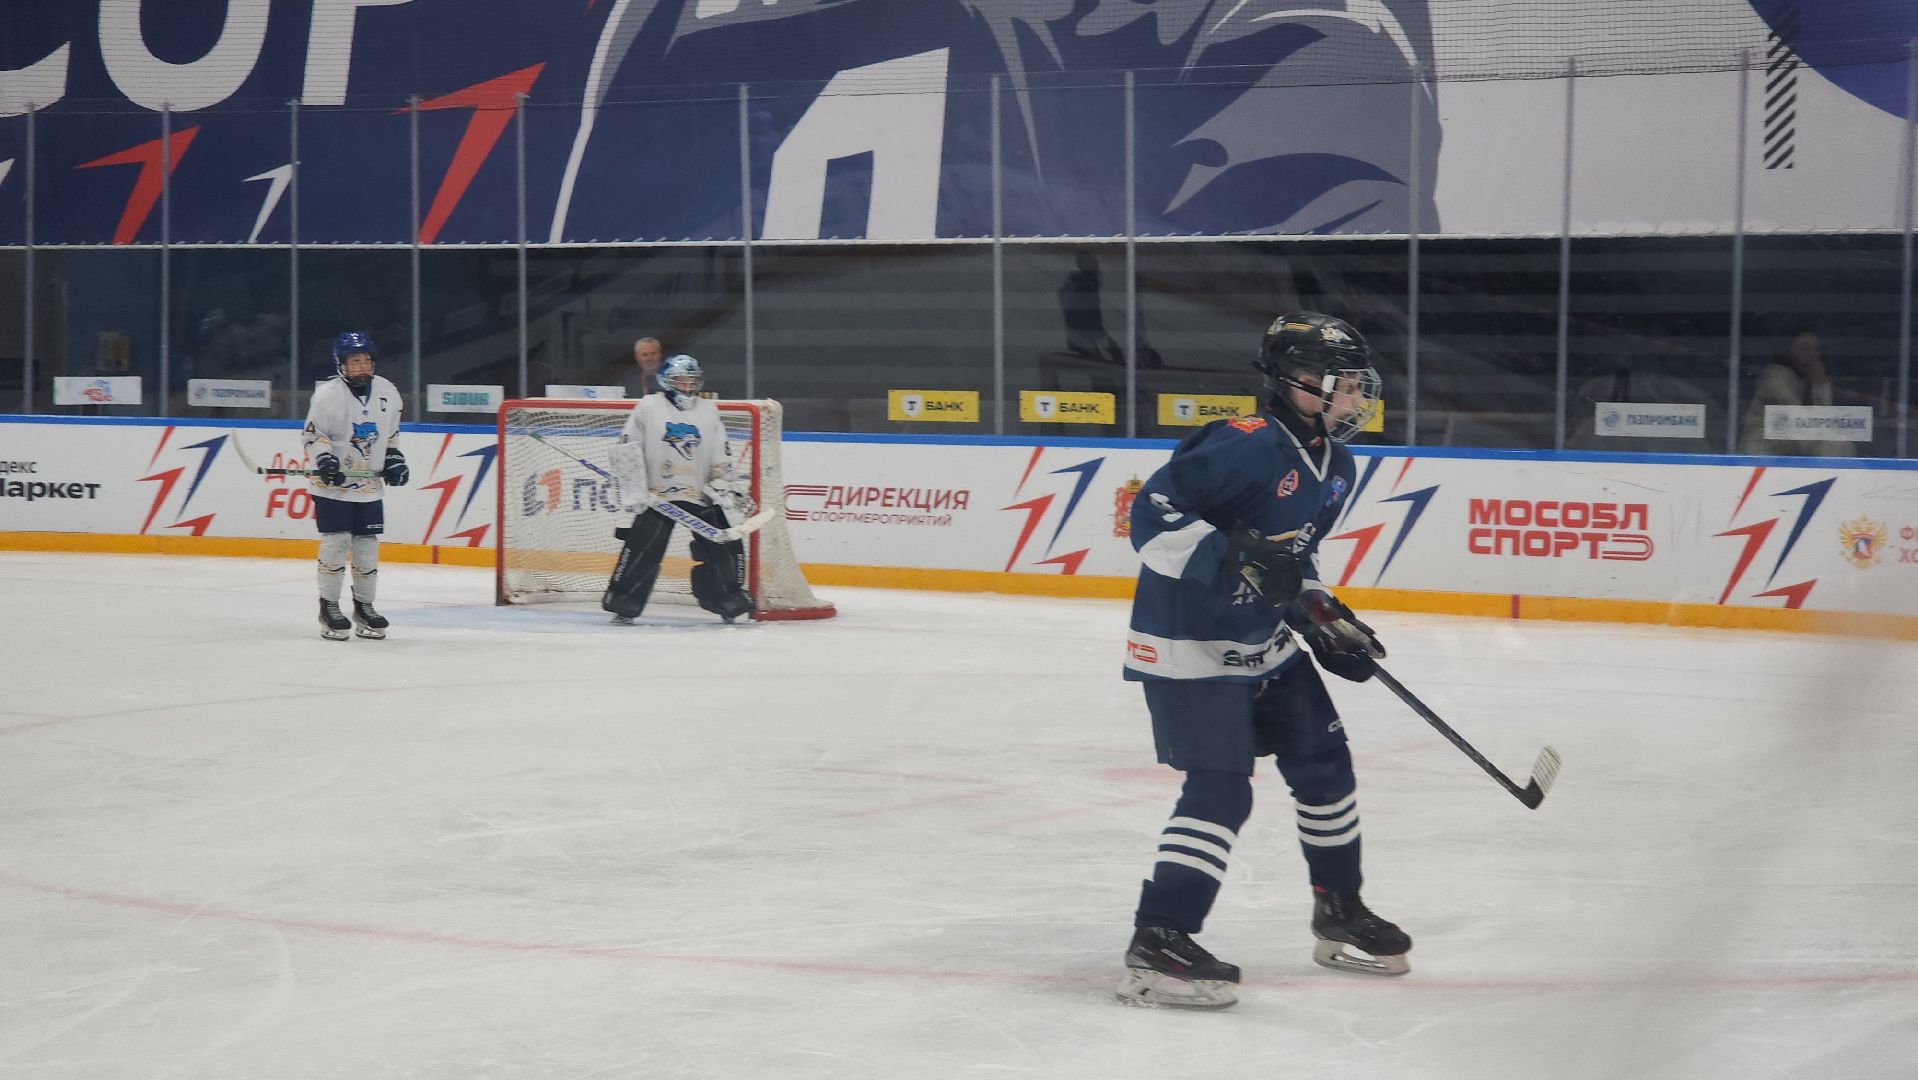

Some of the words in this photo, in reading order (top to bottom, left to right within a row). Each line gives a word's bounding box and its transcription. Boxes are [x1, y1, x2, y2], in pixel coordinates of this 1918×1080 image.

[925, 401, 964, 411] БАНК
[1059, 402, 1100, 413] БАНК
[1199, 405, 1240, 417] БАНК
[264, 488, 317, 520] FO
[824, 485, 970, 513] ДИРЕКЦИЯ
[810, 511, 953, 527] СПОРТМЕРОПРИЯТИЙ
[1469, 498, 1648, 531] МОСОБЛ
[1468, 528, 1608, 560] СПОРТ
